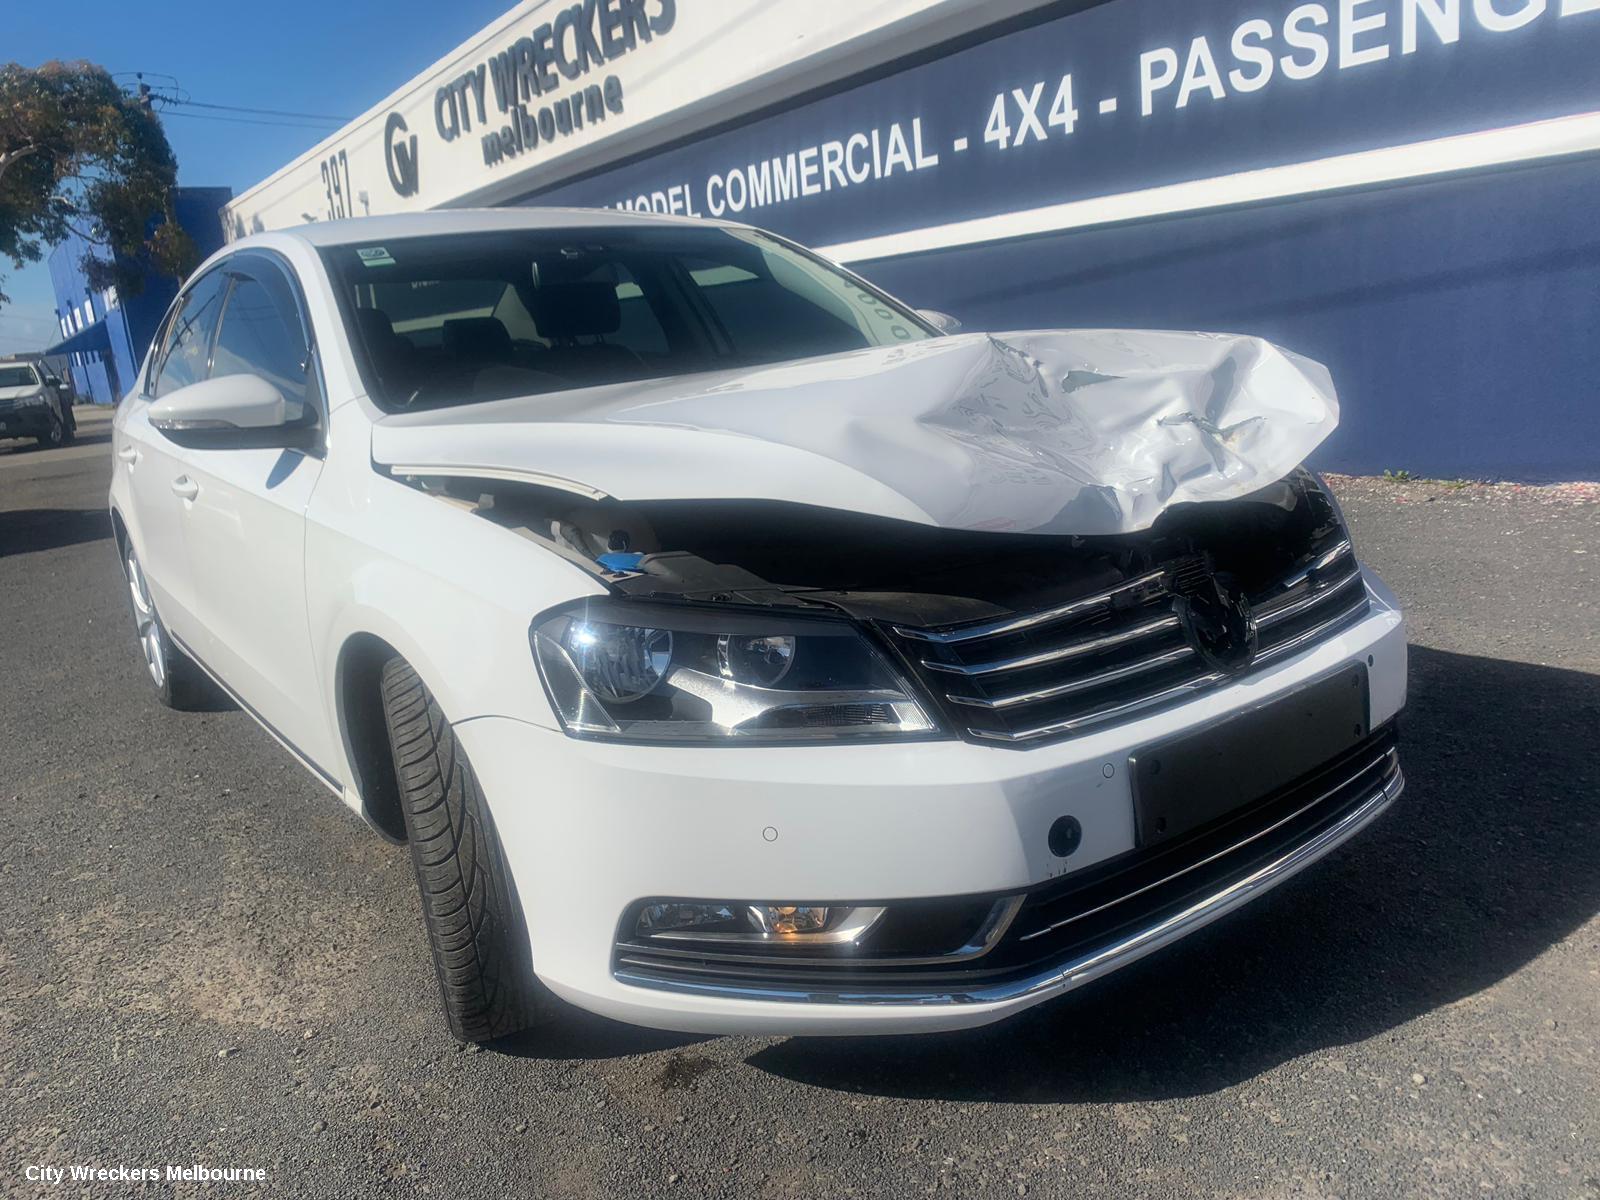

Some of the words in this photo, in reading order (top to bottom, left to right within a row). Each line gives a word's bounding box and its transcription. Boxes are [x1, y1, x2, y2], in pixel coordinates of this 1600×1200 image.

[434, 63, 487, 143] CITY
[481, 74, 624, 168] melbourne
[706, 117, 939, 217] COMMERCIAL
[984, 73, 1078, 150] 4X4
[1139, 0, 1600, 117] PASSEN
